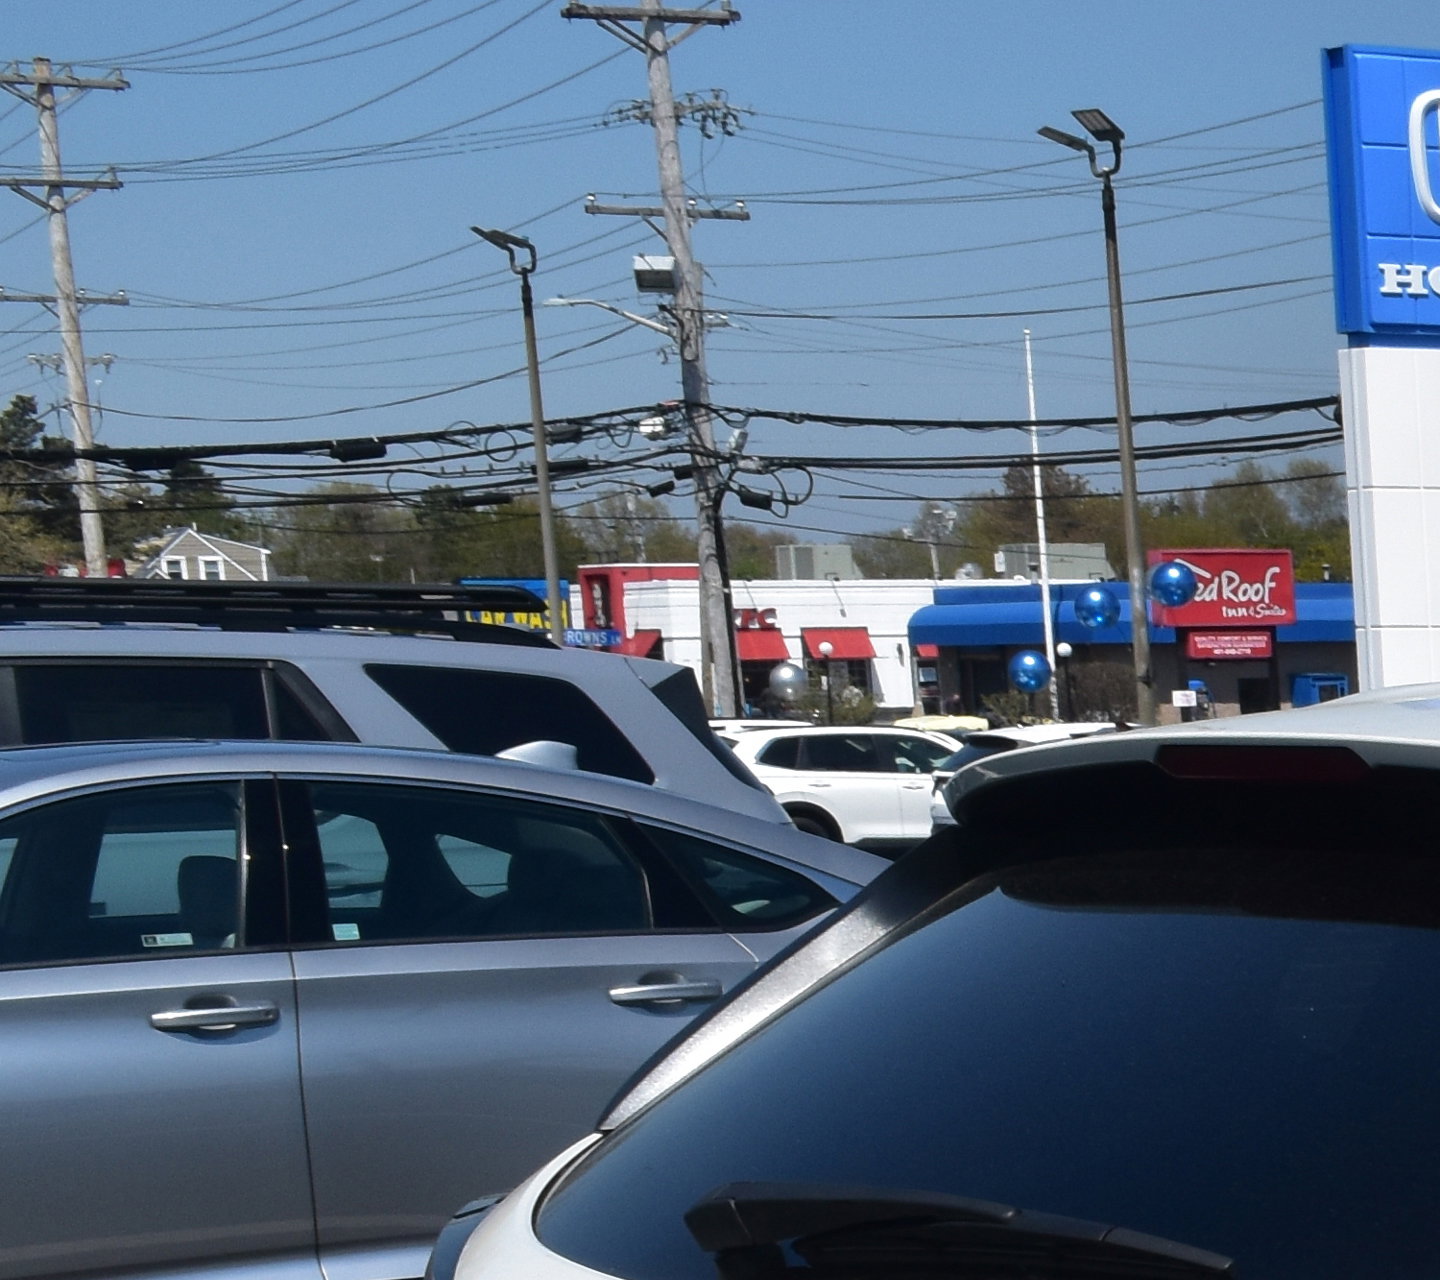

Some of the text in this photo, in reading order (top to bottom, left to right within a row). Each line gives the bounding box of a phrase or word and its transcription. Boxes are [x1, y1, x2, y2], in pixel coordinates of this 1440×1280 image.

[1193, 567, 1280, 603] ed Roof
[564, 630, 607, 645] ROWNS
